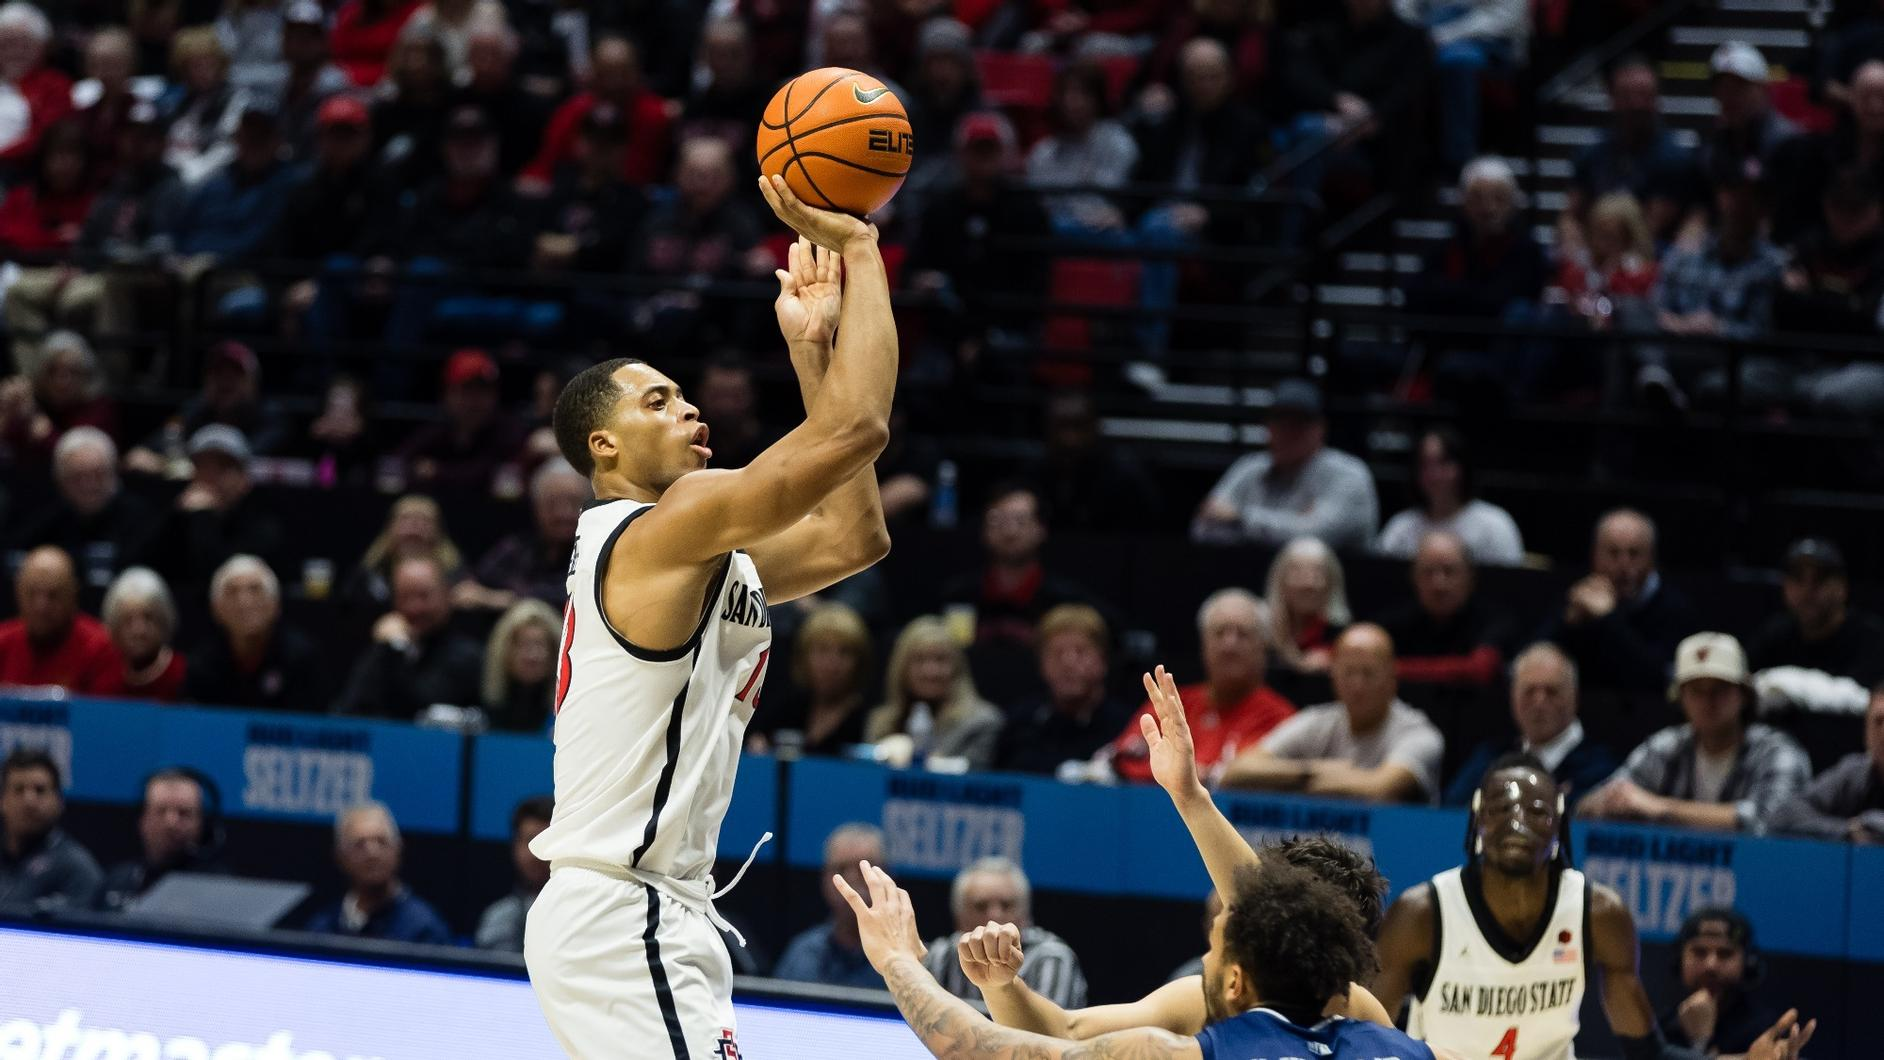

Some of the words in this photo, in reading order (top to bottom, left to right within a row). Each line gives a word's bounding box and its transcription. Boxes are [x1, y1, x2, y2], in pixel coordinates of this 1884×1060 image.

[735, 647, 769, 709] 1
[1440, 982, 1472, 1014] SAN
[1476, 984, 1527, 1016] DIEGO
[1490, 1025, 1519, 1060] 4
